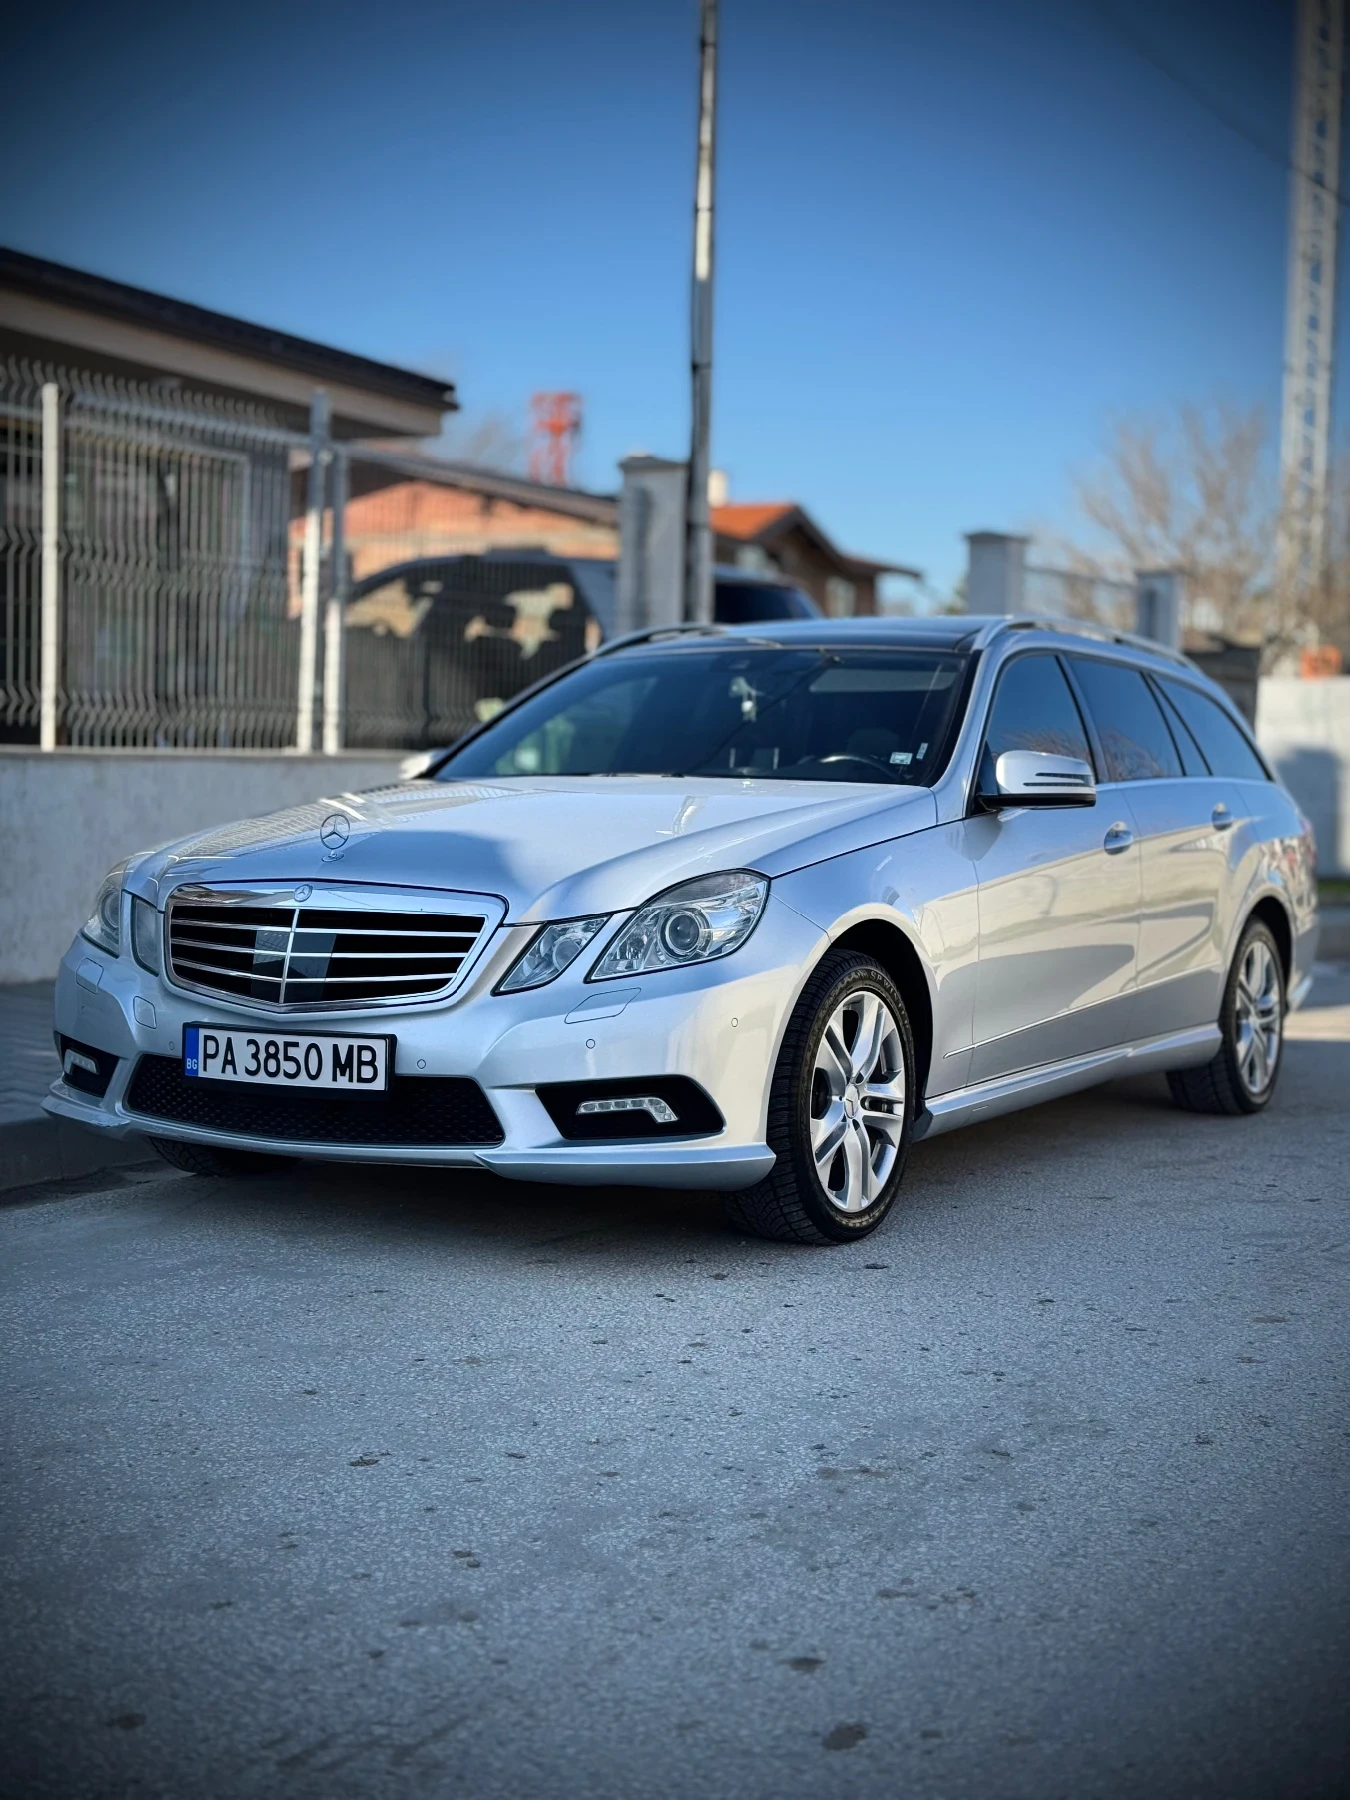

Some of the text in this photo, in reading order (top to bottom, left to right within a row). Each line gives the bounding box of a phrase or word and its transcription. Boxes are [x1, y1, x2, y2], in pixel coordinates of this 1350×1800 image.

[186, 1058, 198, 1070] BG
[203, 1034, 379, 1084] PA 3850 MB
